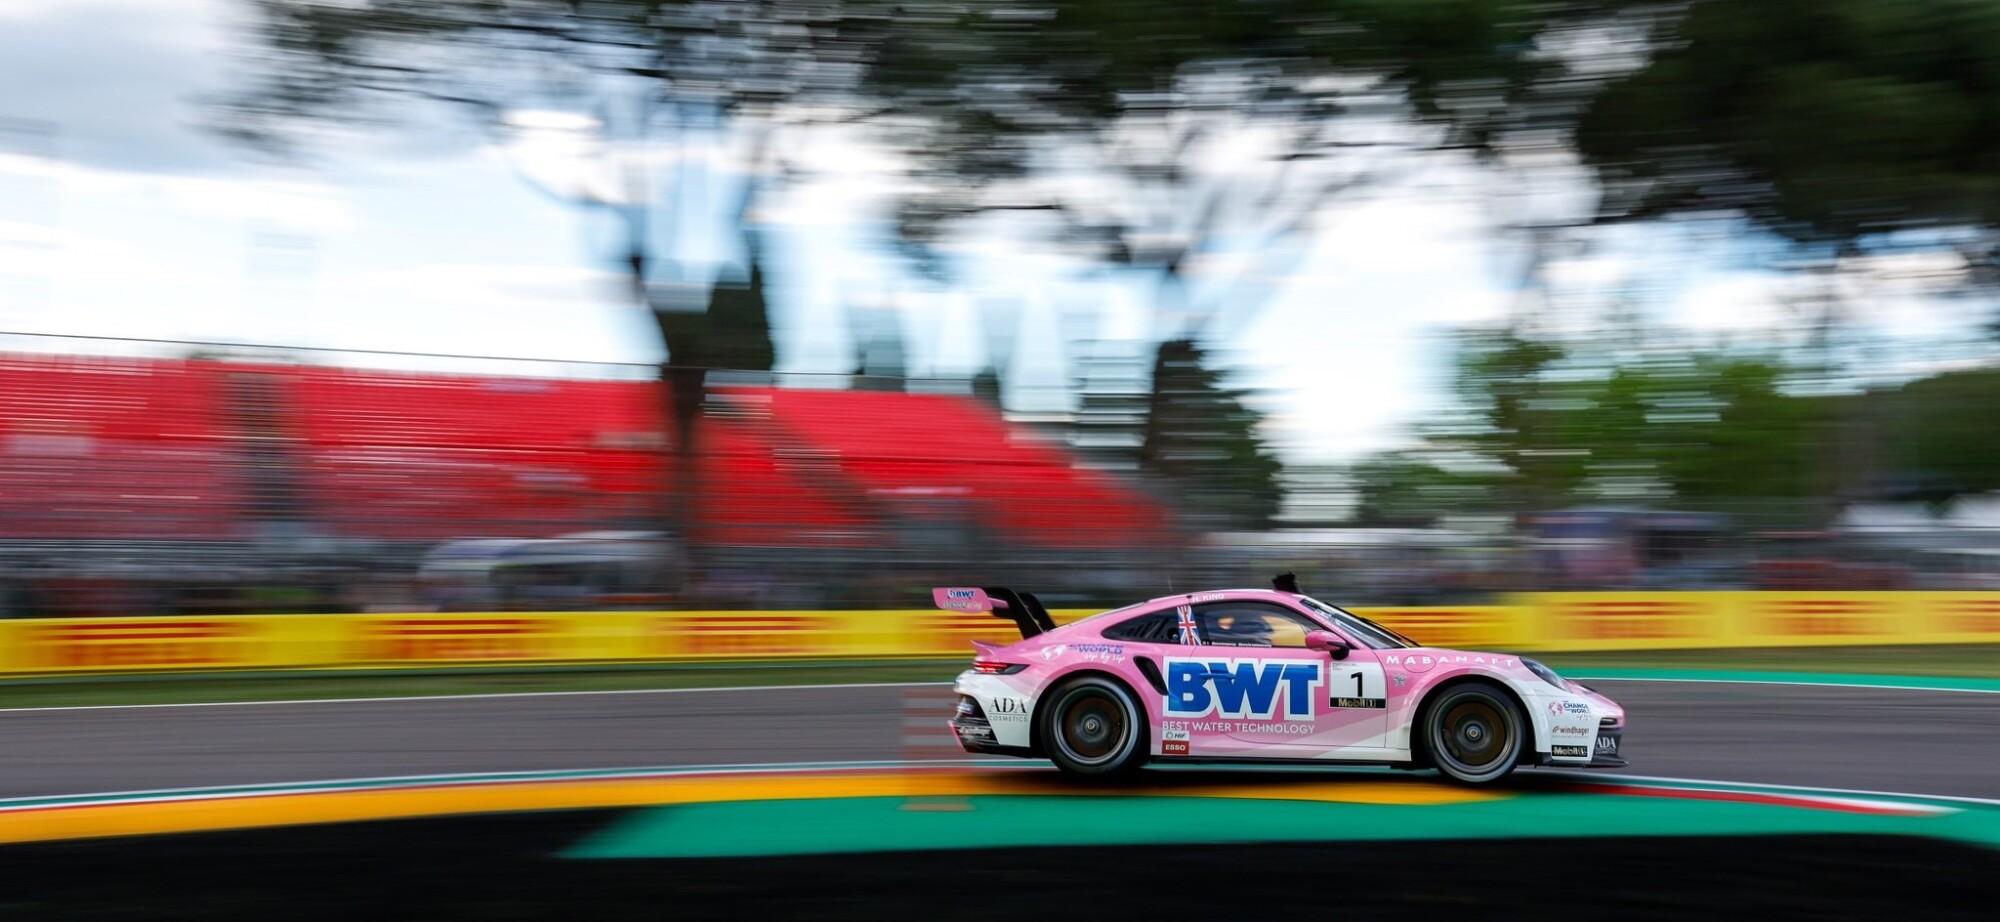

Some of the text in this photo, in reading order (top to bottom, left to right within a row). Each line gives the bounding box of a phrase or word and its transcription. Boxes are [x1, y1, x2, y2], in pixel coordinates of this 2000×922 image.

[1079, 646, 1122, 655] WORLD
[1386, 655, 1514, 667] MABANAFT
[1168, 661, 1318, 715] BWT
[1351, 672, 1363, 697] 1
[989, 697, 1027, 713] ADA
[1338, 698, 1365, 707] Mobil
[1162, 721, 1315, 734] BEST WATER TECHNOLOGY
[1560, 726, 1590, 736] windhager
[1596, 737, 1616, 748] ADA
[1553, 747, 1578, 755] Mobil
